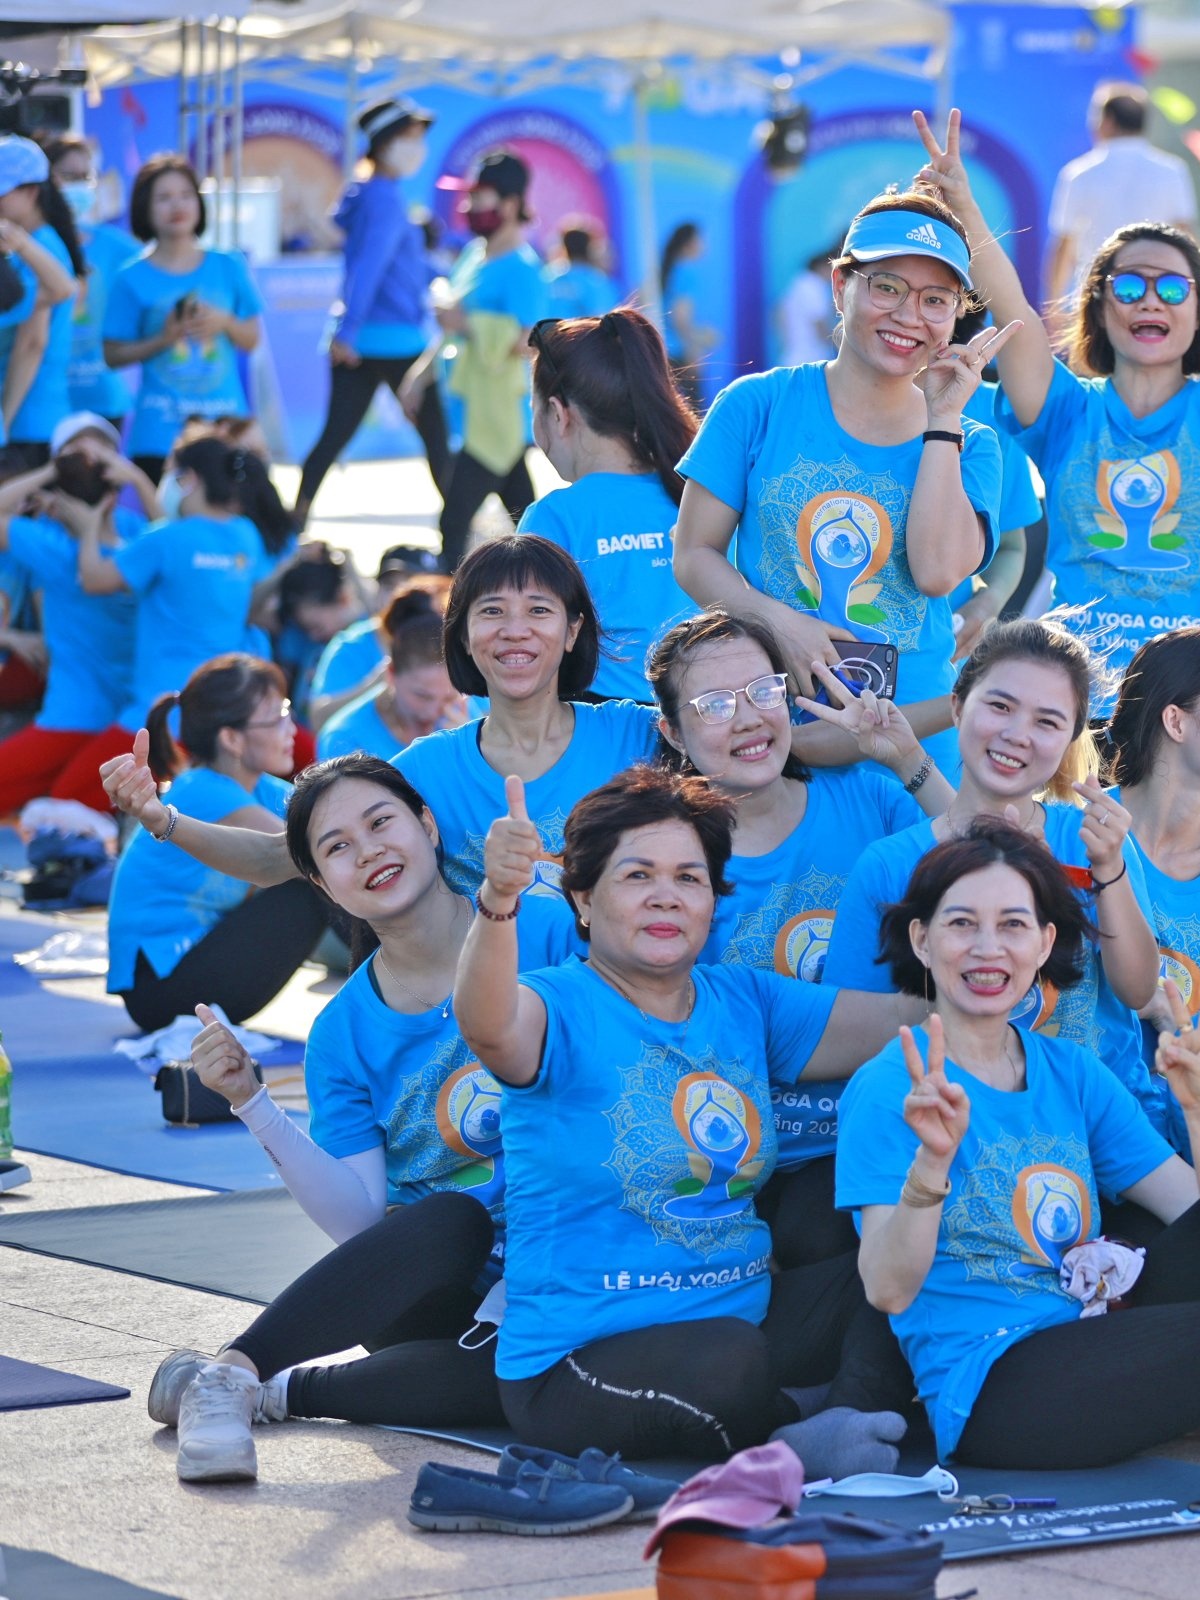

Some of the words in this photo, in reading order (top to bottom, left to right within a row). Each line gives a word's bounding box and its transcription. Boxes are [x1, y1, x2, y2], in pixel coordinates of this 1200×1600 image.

[905, 232, 942, 250] adidas
[811, 498, 852, 526] International
[853, 500, 868, 513] Day
[870, 521, 879, 542] Yoga
[597, 532, 664, 556] BAOVIET
[1097, 612, 1146, 629] YOGA
[808, 919, 824, 927] Day
[712, 1081, 726, 1093] Day
[770, 1091, 812, 1109] OGA
[773, 1113, 803, 1135] ẵng
[689, 1266, 741, 1287] YOGA
